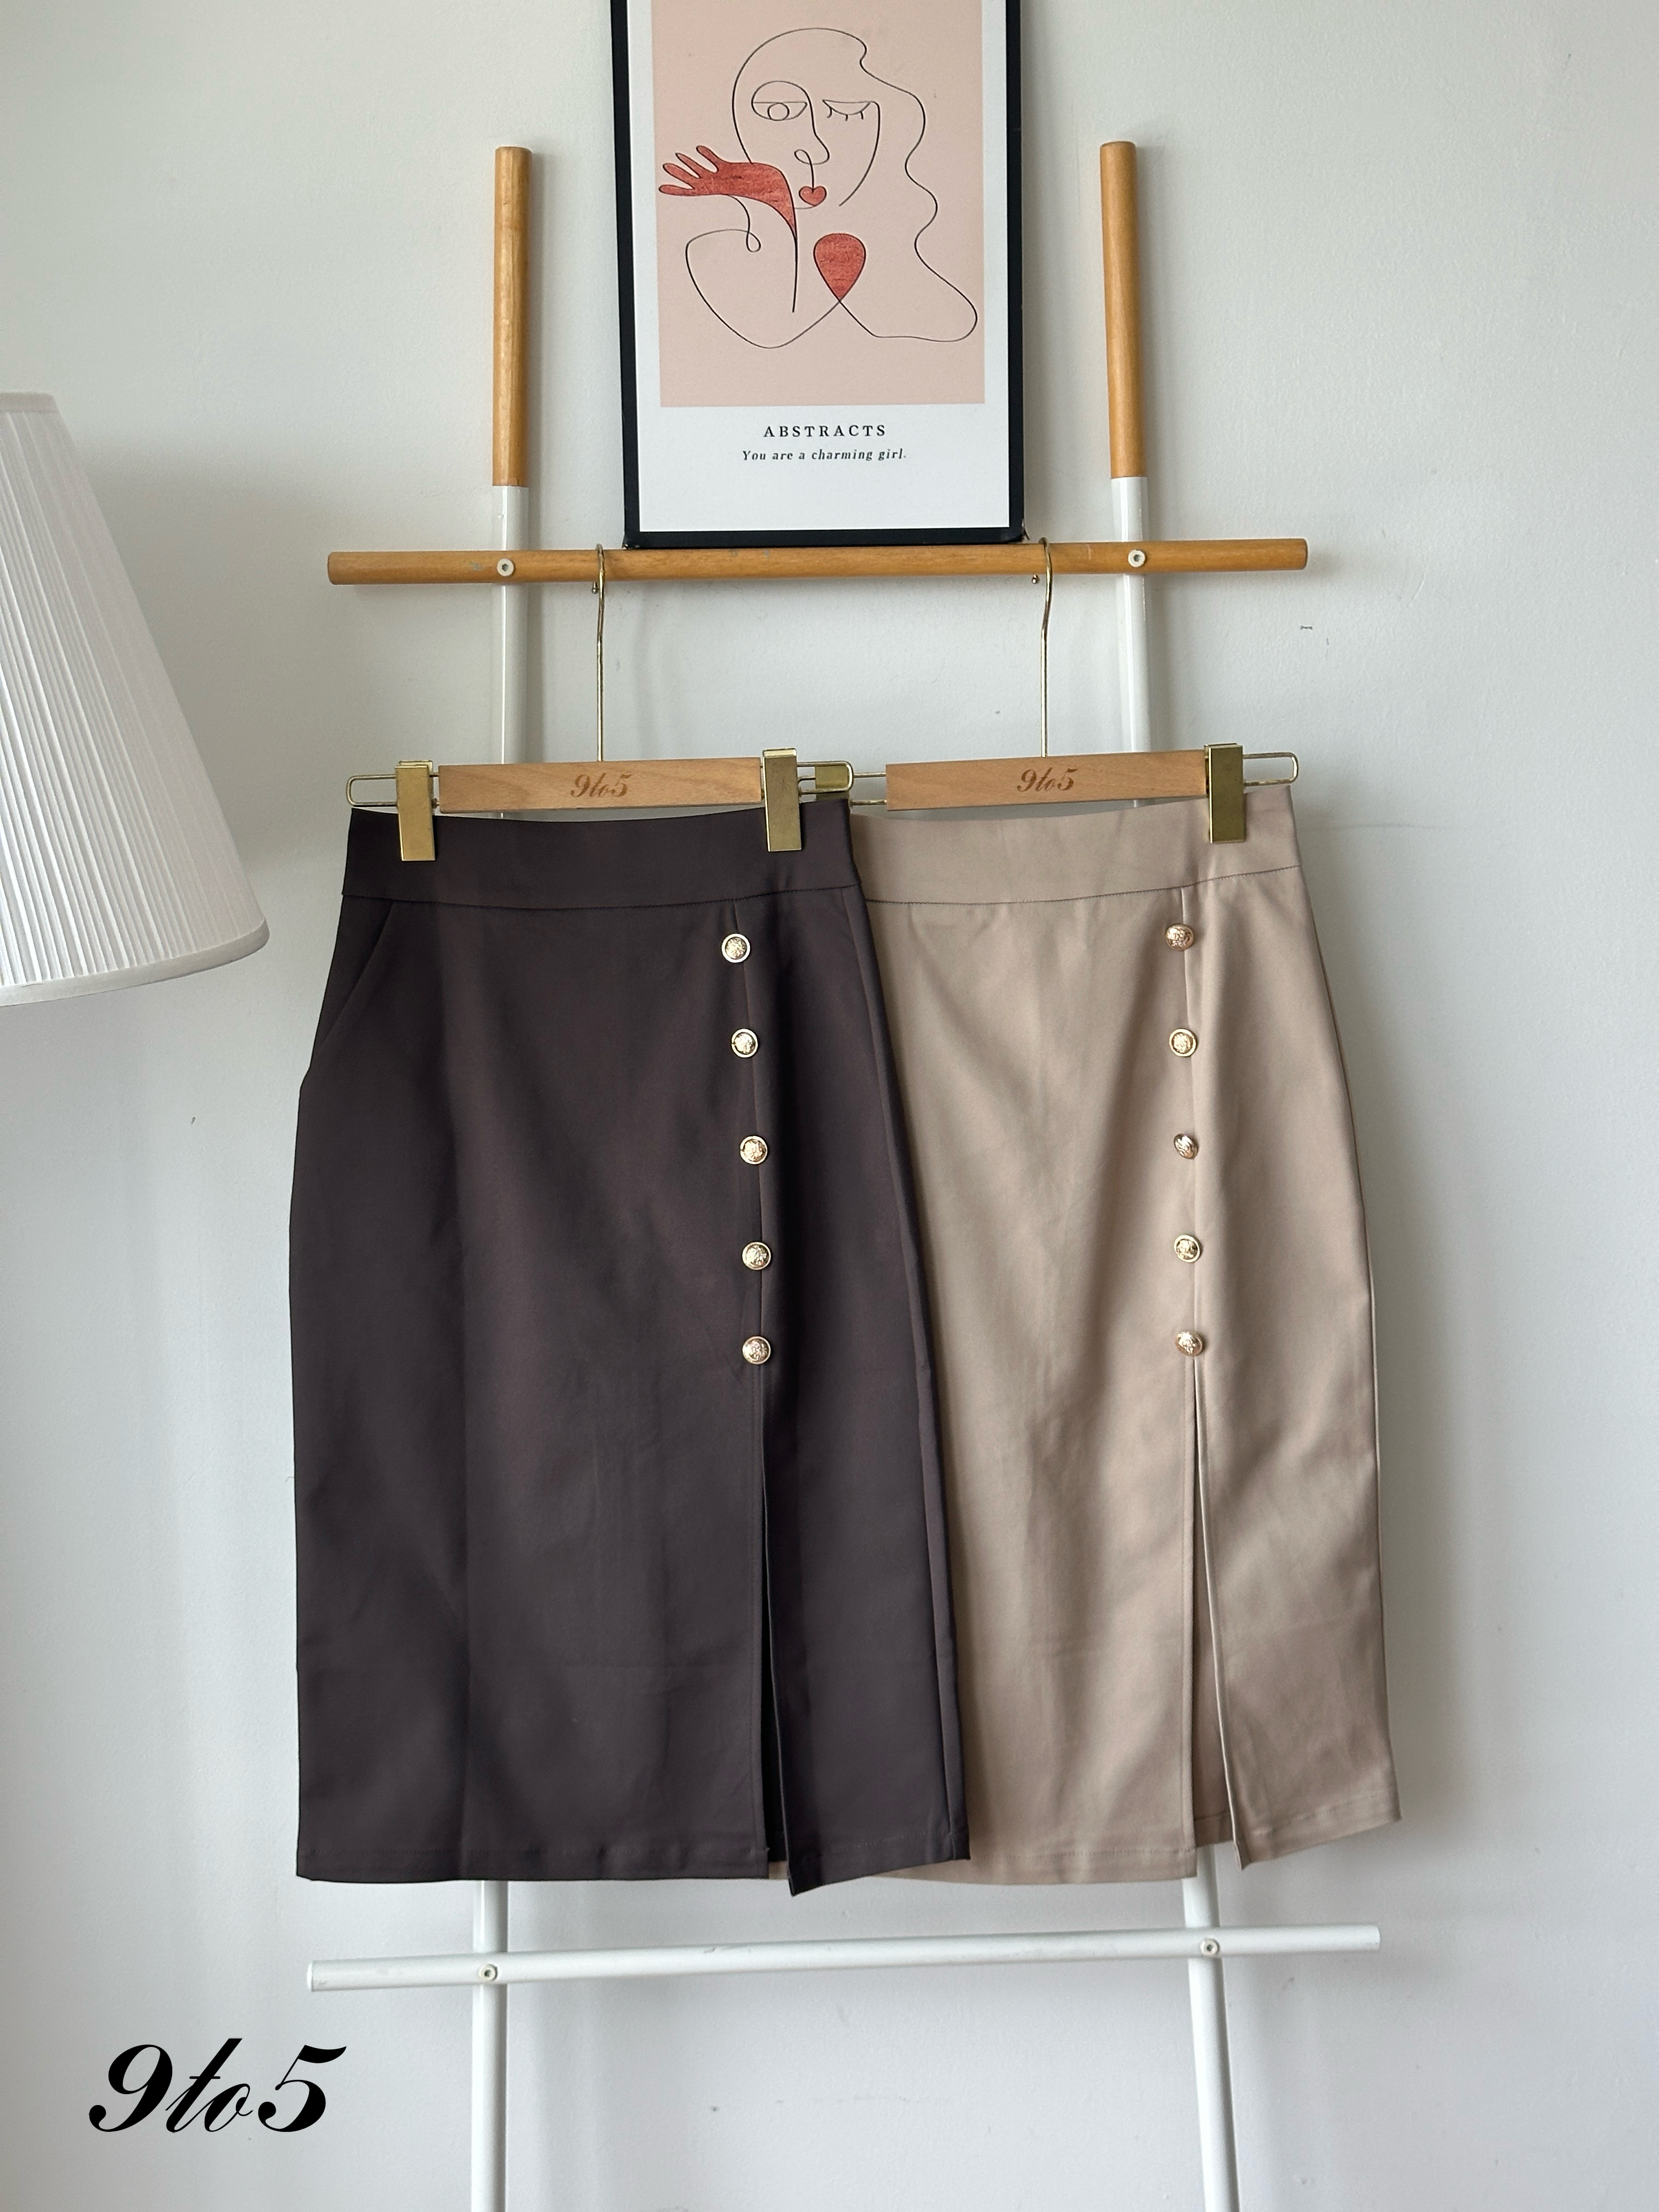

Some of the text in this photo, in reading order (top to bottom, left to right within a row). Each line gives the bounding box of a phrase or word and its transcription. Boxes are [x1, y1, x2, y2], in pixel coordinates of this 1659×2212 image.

[764, 425, 886, 438] ABSTRACTS
[742, 448, 907, 461] You are a charming girl.
[570, 772, 633, 798] 9to5
[1017, 767, 1078, 792] 9to5
